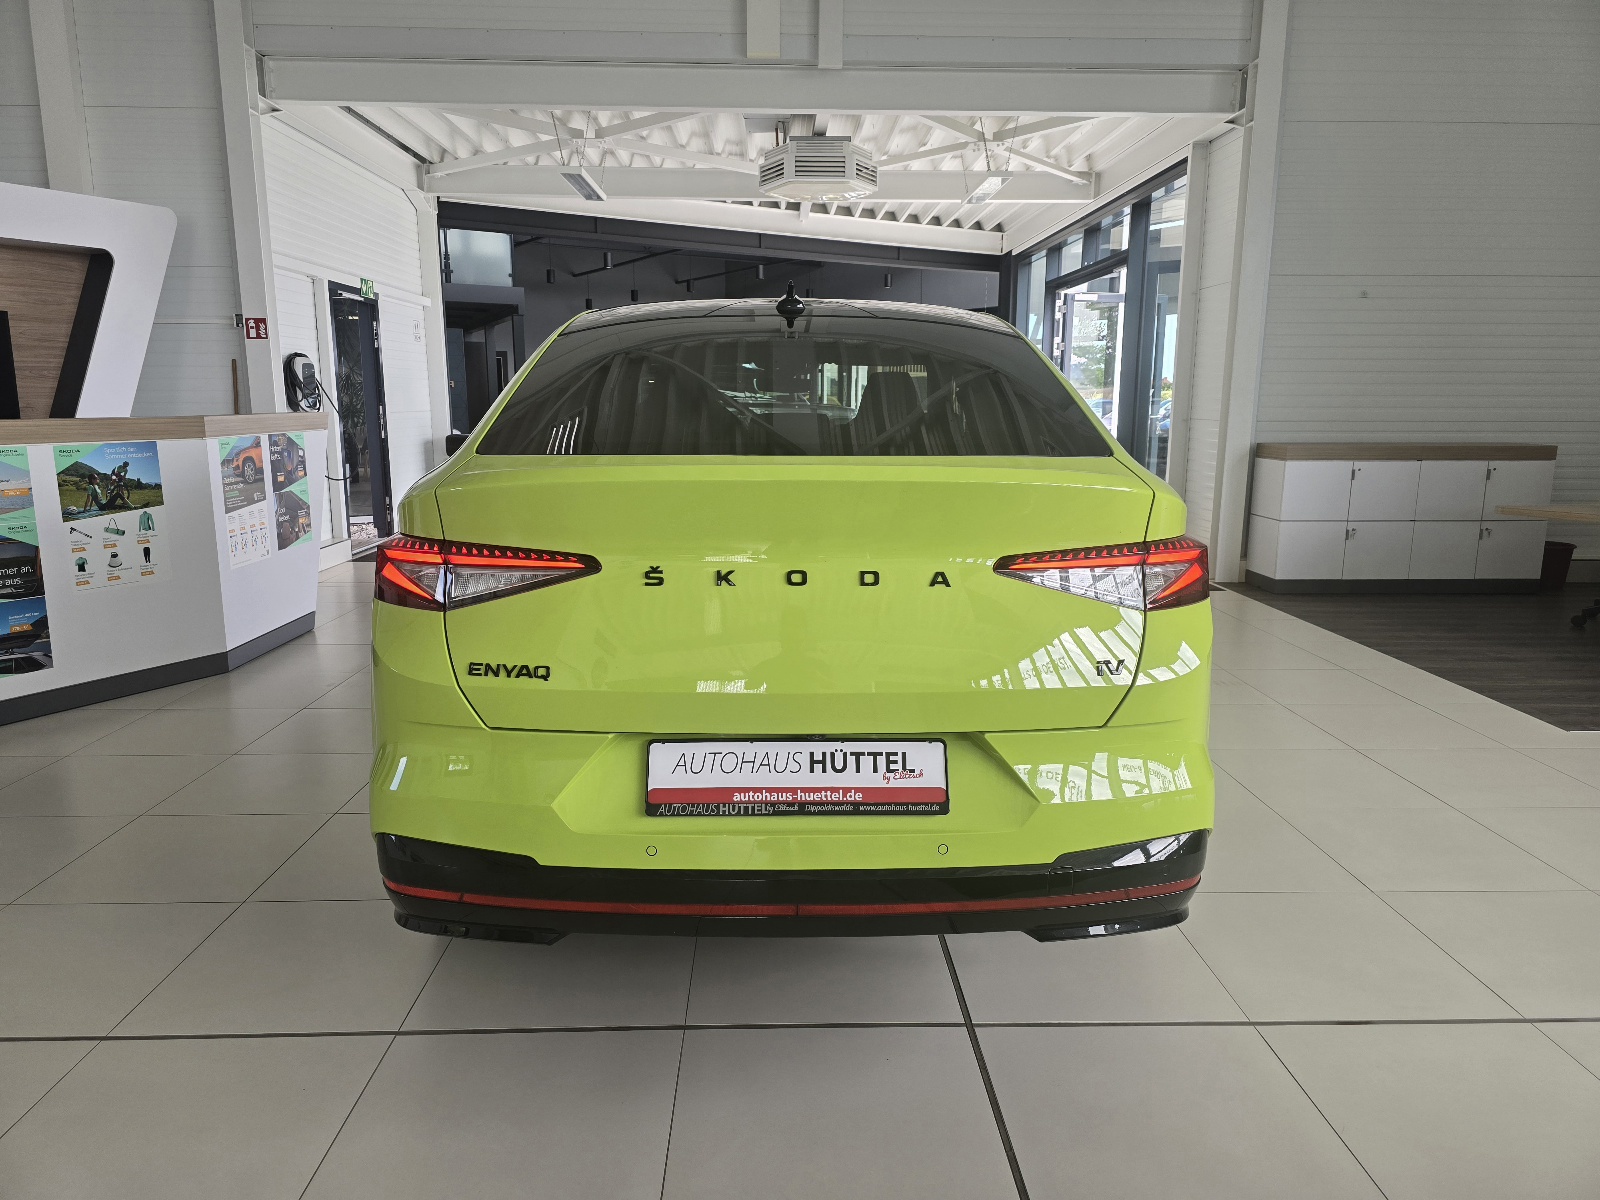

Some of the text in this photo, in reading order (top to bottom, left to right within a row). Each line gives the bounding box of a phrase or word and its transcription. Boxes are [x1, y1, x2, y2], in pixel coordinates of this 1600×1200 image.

[20, 565, 34, 574] an.
[5, 577, 24, 586] aus.
[644, 566, 951, 587] ŠKODA
[467, 662, 551, 681] ENYAQ
[671, 748, 916, 775] AUTOHAUS HÜTTEL
[882, 772, 891, 785] by
[733, 789, 863, 802] autohaus-huettel.de
[656, 803, 718, 816] AUTOHAUS
